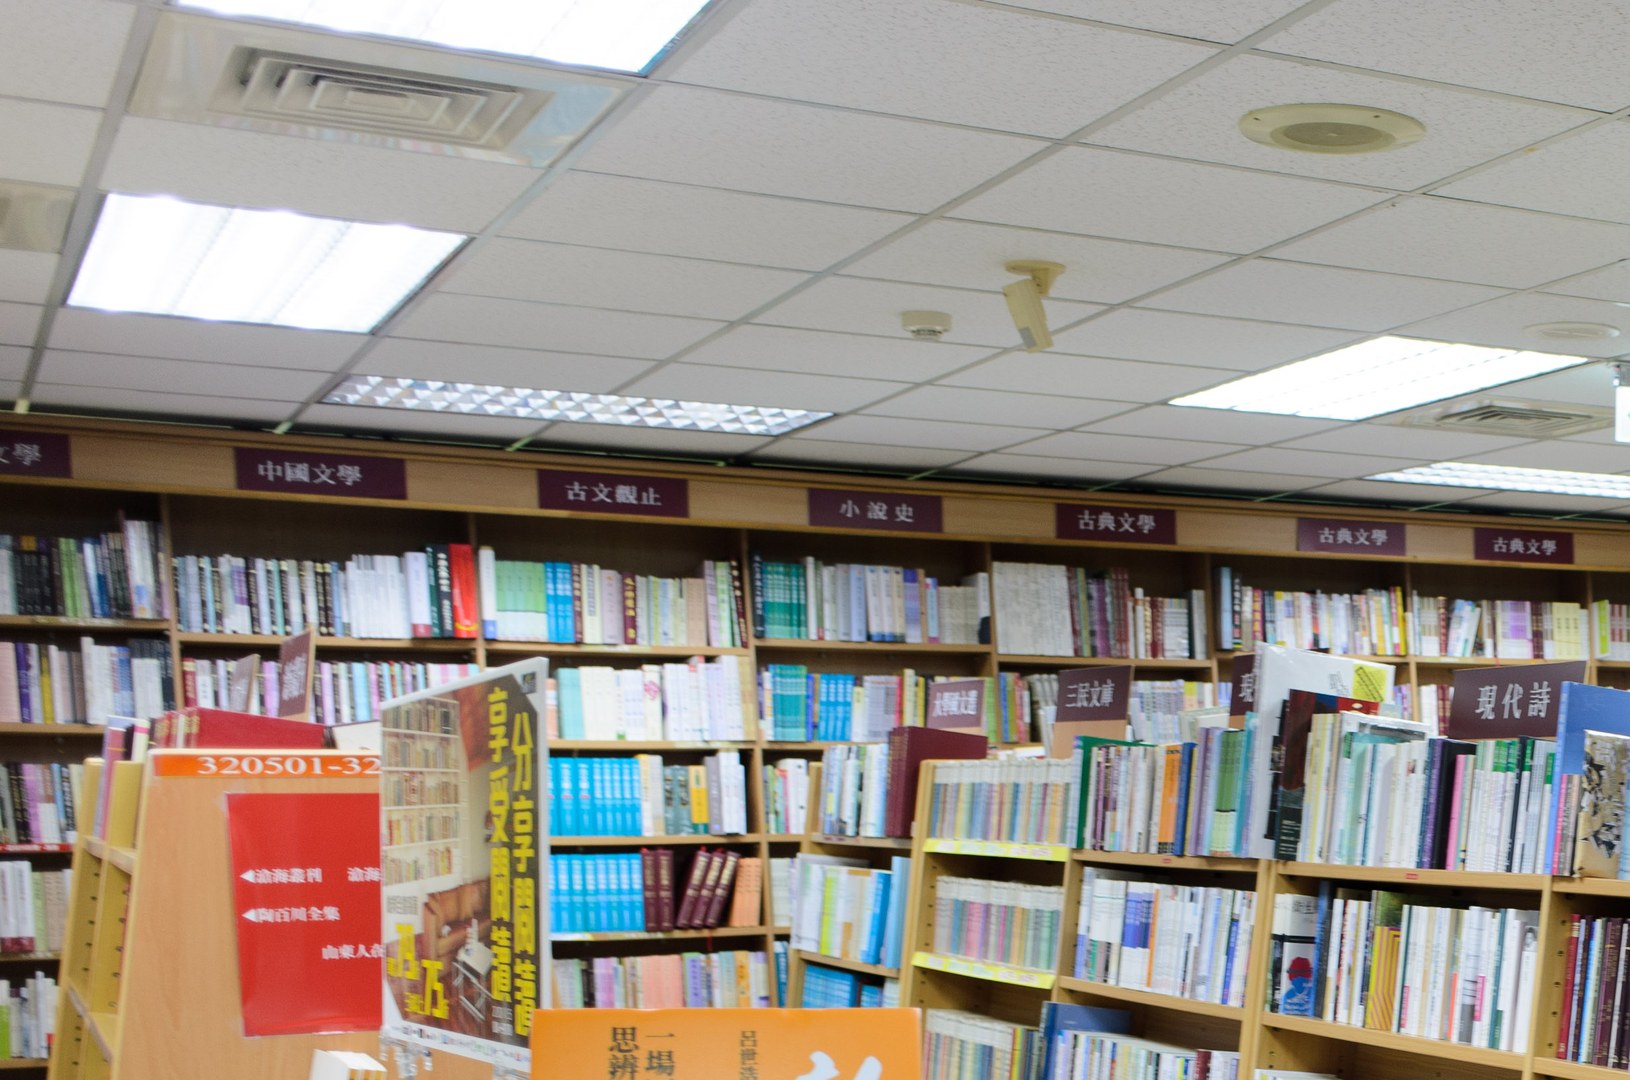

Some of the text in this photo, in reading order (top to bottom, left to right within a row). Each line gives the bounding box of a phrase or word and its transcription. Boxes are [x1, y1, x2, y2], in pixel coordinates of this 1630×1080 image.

[257, 460, 363, 487] 中國文學
[565, 481, 662, 506] 古文觀止
[839, 499, 914, 523] 小說史
[1077, 510, 1156, 534] 古典文學
[1317, 527, 1388, 546] 古典文學
[1492, 537, 1557, 556] 古典文學
[1065, 679, 1116, 709] 三民文庫
[1474, 681, 1551, 720] 現代詩
[196, 756, 381, 776] 320501-32
